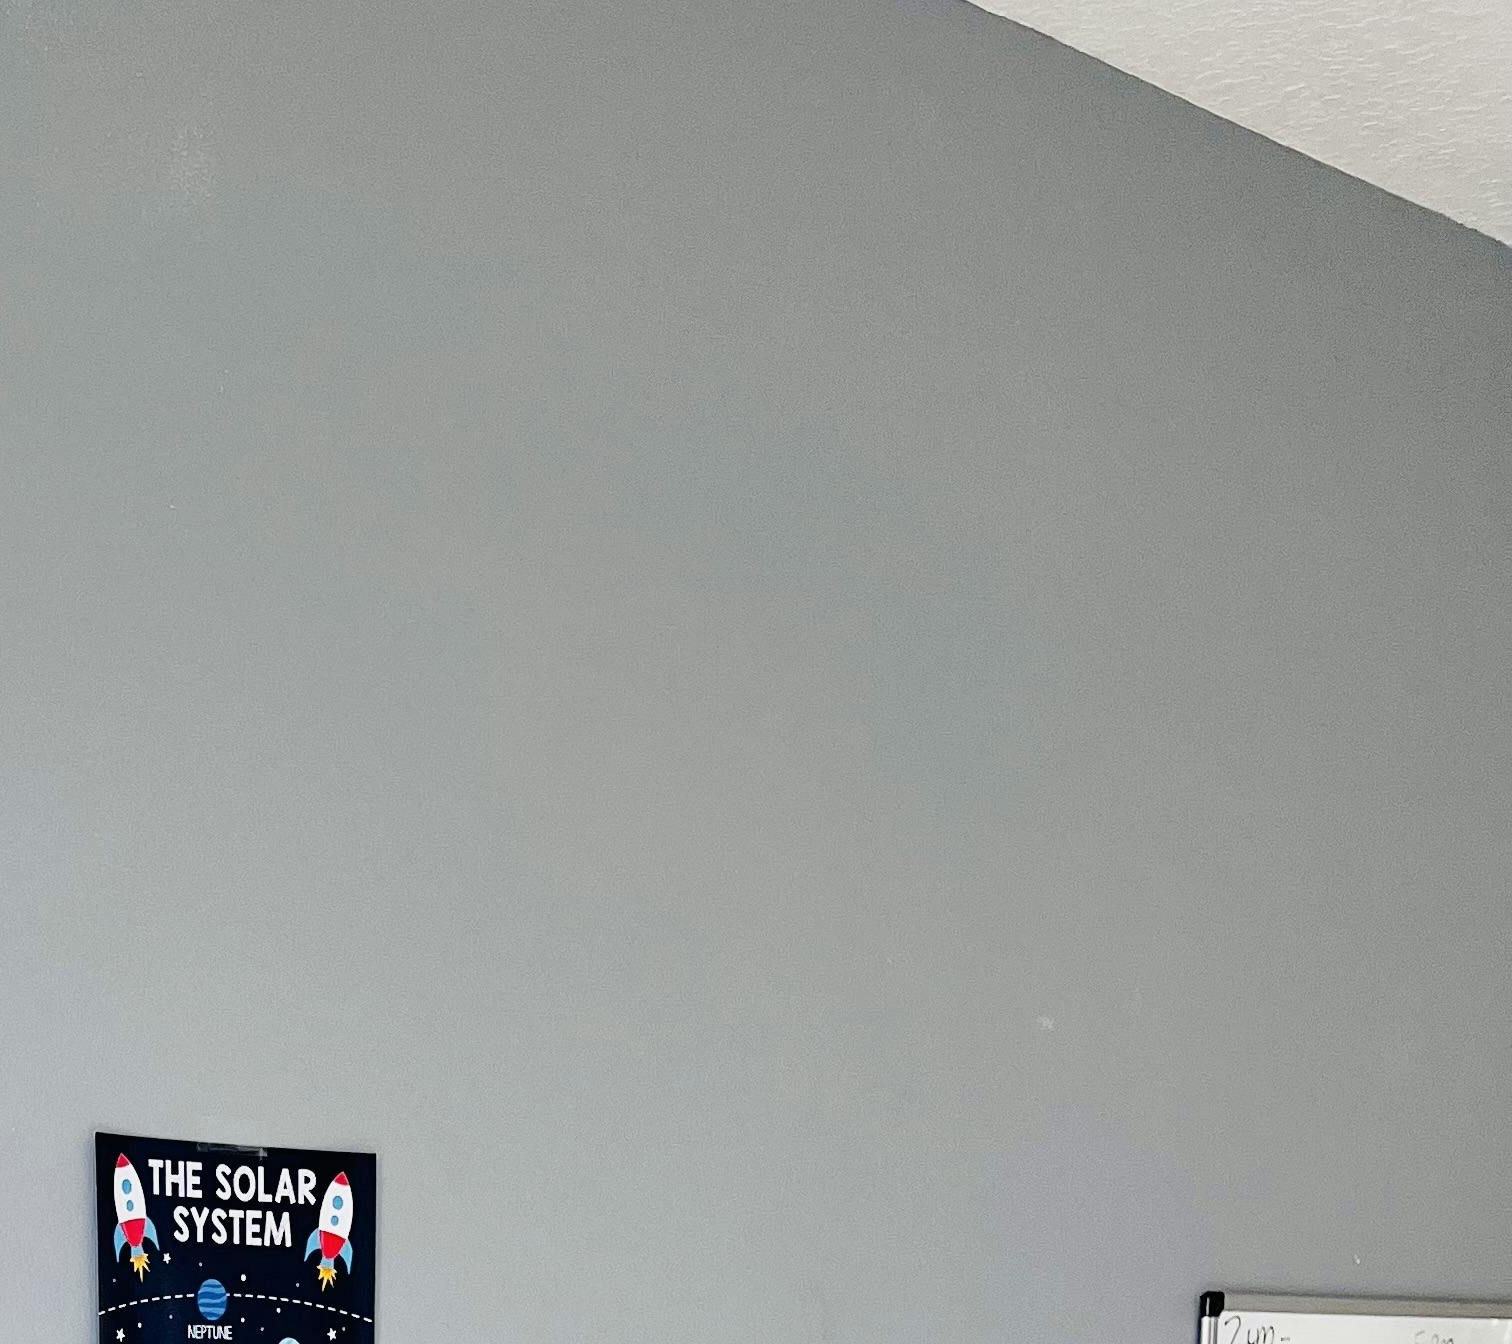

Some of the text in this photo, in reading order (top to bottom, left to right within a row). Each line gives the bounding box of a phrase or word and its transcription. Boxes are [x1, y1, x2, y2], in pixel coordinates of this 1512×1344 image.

[148, 1159, 316, 1206] THE SOLAR
[174, 1206, 292, 1248] SYSTEM
[188, 1324, 232, 1340] NEPTUNE
